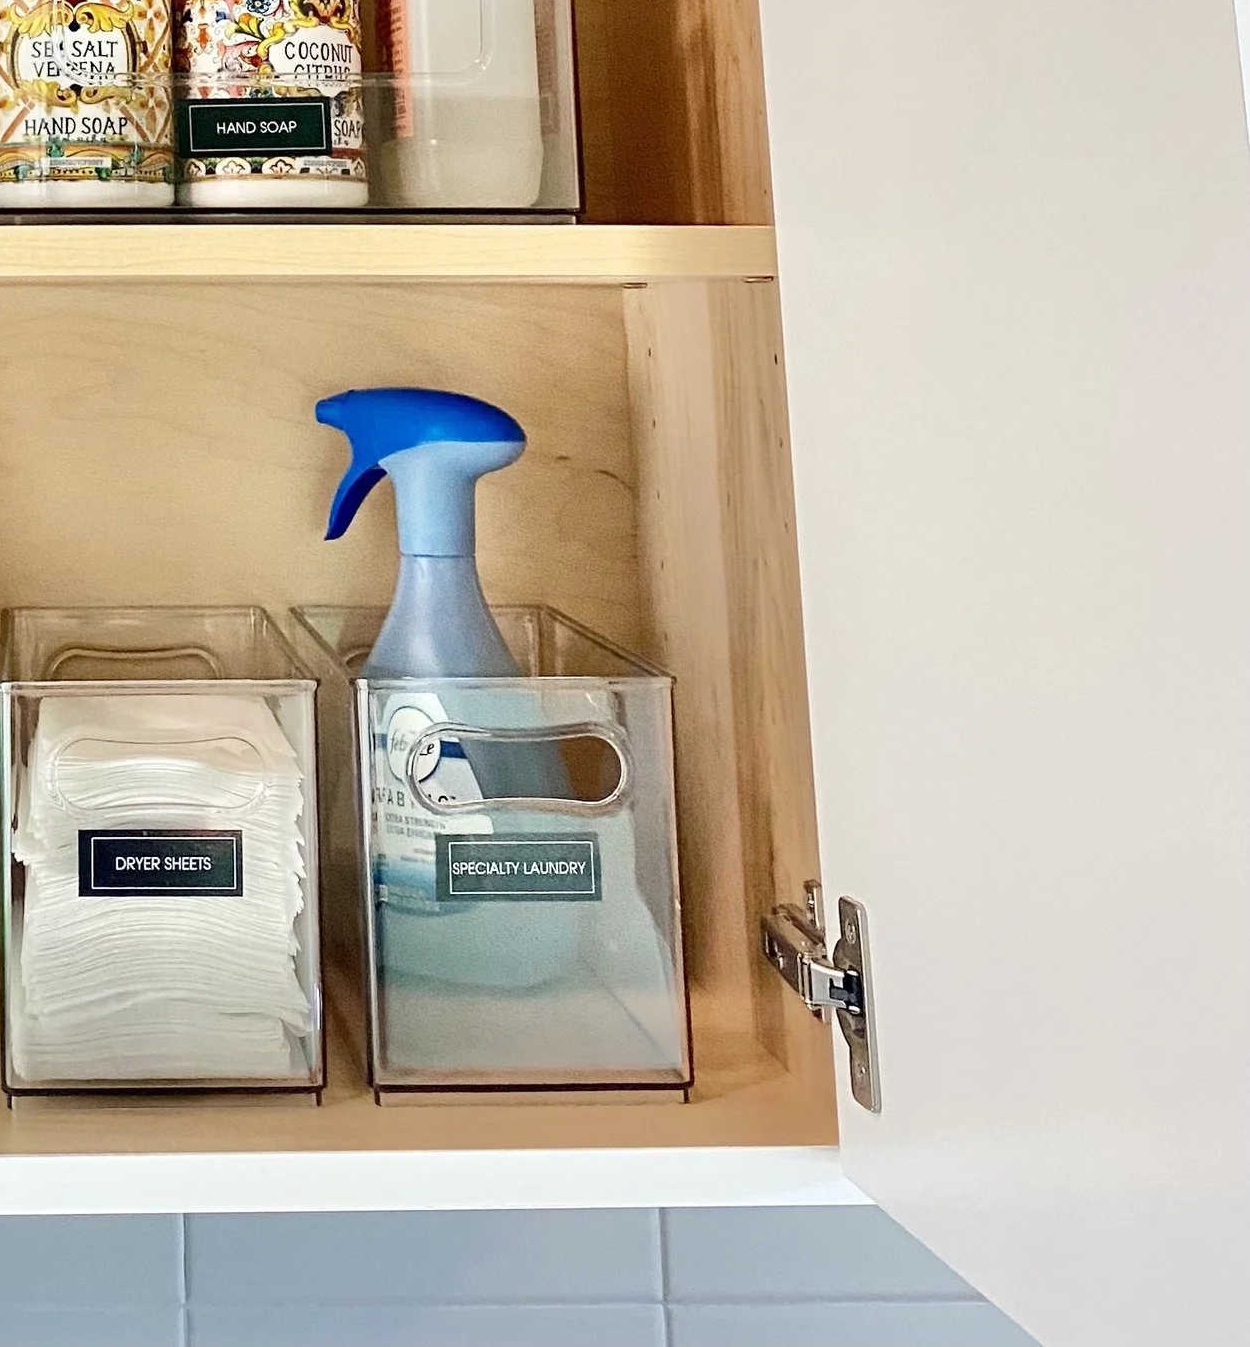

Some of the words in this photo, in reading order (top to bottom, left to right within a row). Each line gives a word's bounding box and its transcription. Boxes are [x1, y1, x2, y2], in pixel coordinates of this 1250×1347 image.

[71, 40, 118, 58] SALT
[284, 41, 353, 64] COCONUT
[24, 117, 76, 136] HAND
[81, 116, 128, 135] SOAP
[216, 122, 257, 135] HAND
[260, 120, 298, 134] SOAP
[334, 119, 362, 139] SOAP
[115, 856, 161, 871] DRYER
[164, 856, 212, 871] SHEETS
[452, 861, 520, 875] SPECIALTY
[524, 861, 587, 875] LAUNDRY
